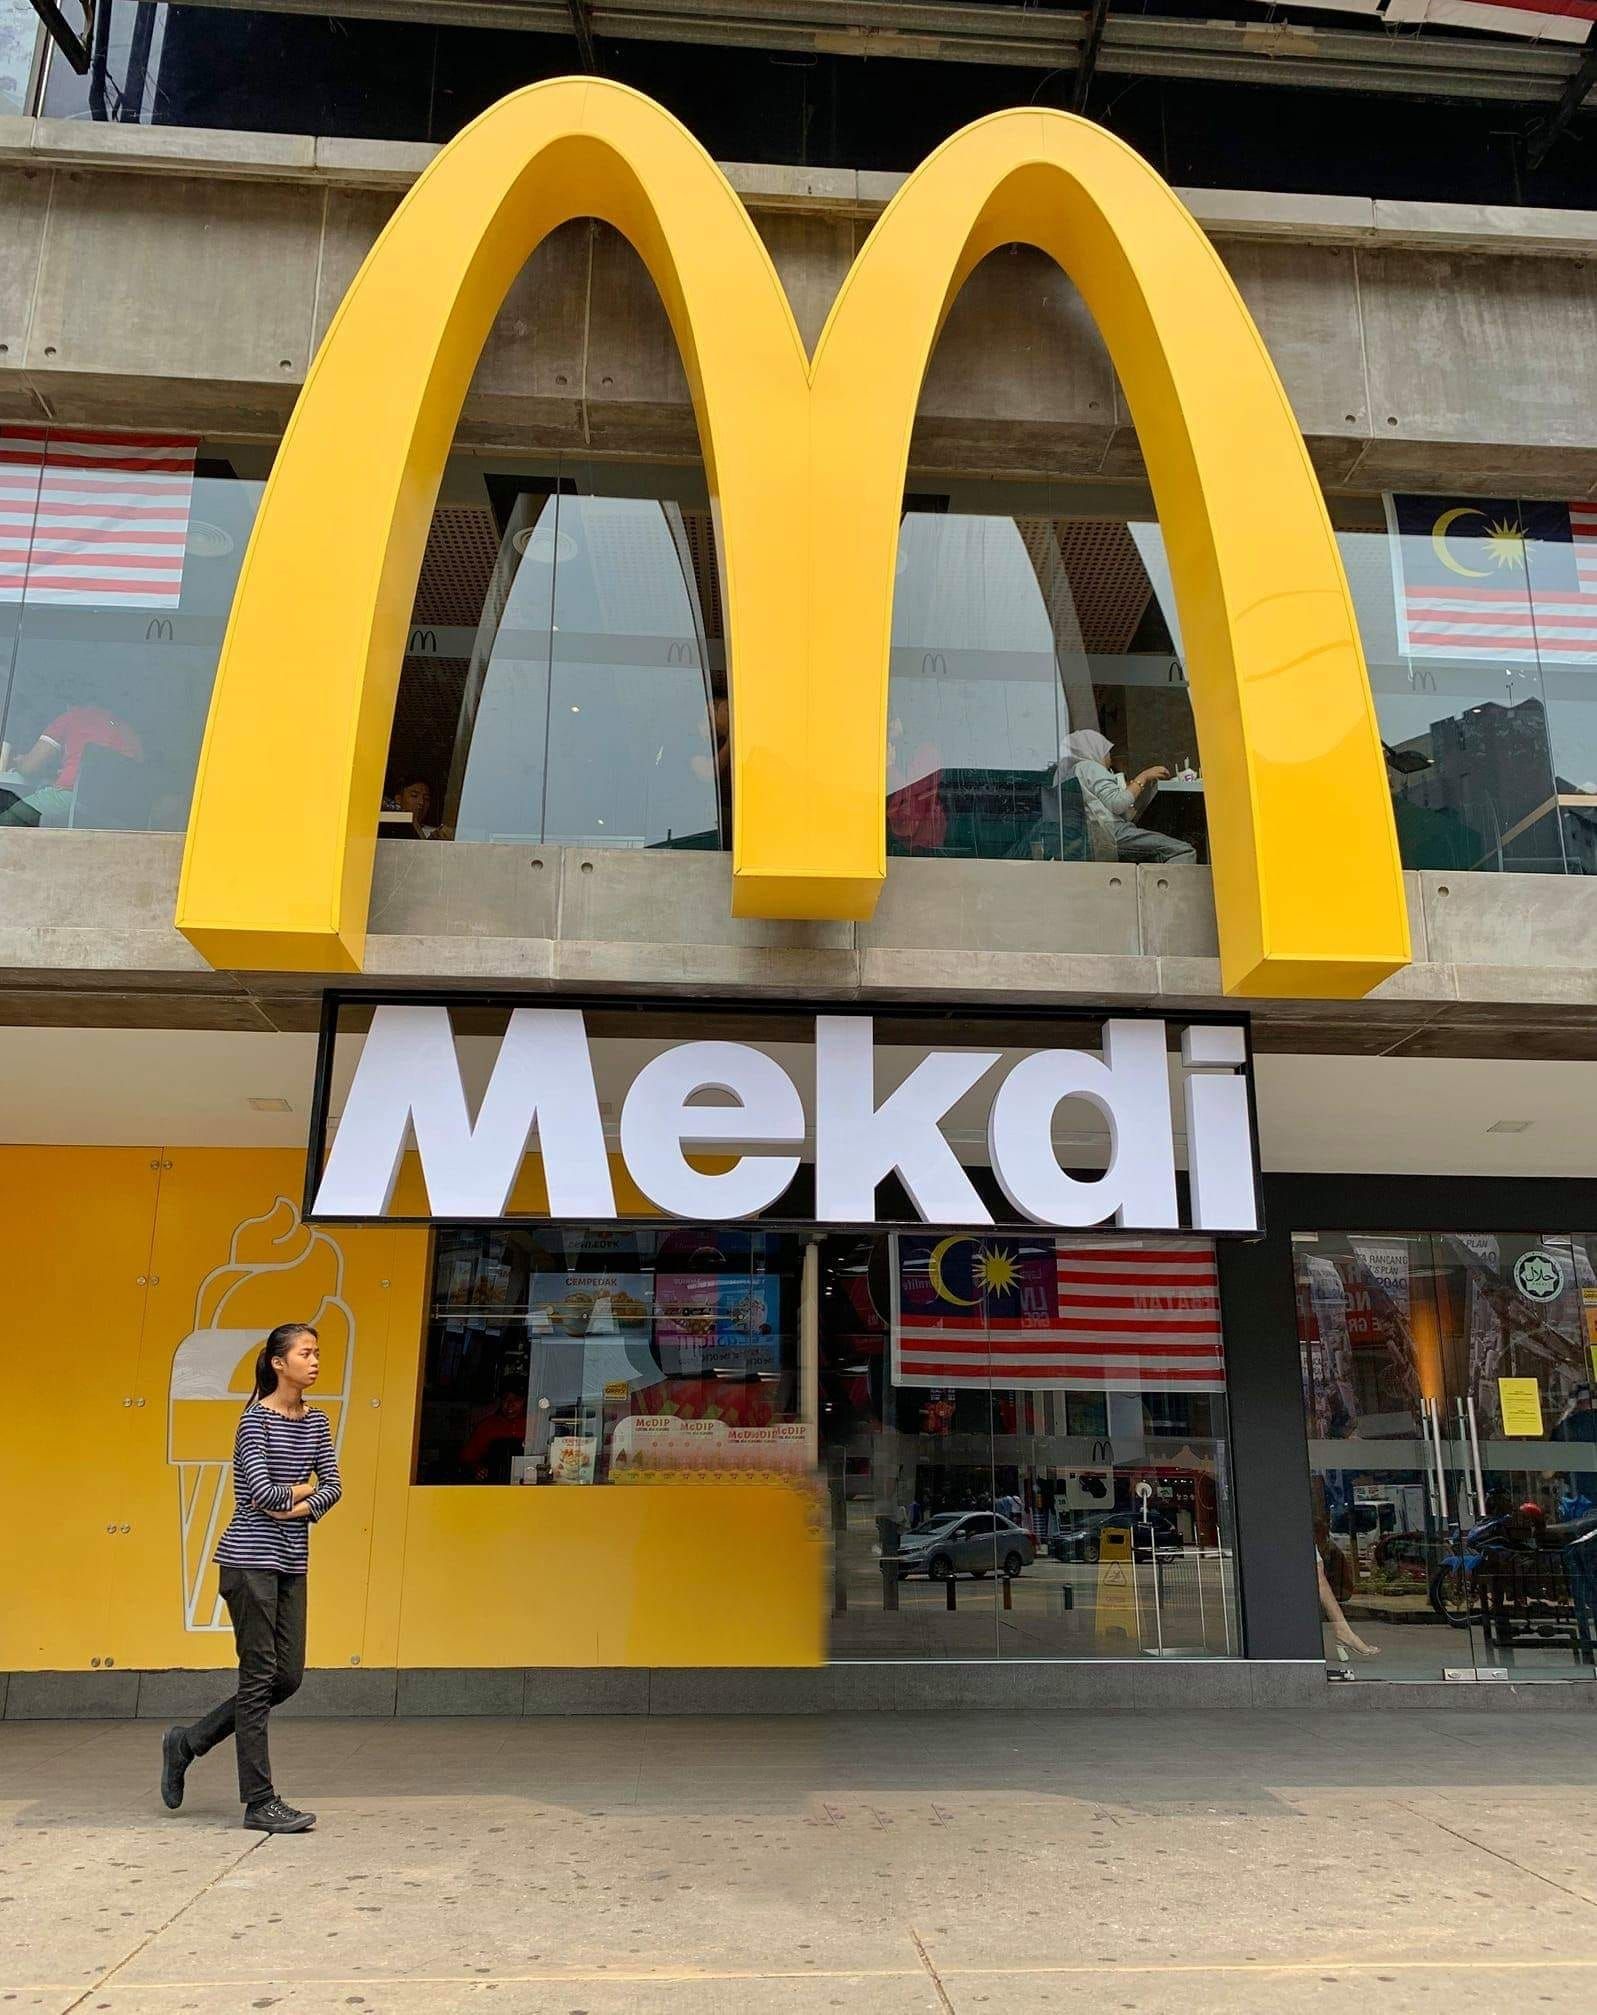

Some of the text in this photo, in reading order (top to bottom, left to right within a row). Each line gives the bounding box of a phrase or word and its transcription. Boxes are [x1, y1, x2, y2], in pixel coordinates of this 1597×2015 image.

[310, 1004, 1257, 1231] Mekdi
[1525, 1266, 1555, 1282] حلال
[565, 1277, 618, 1288] CEMPEDAK
[635, 1418, 671, 1428] McDIP
[680, 1421, 715, 1432] McDIP
